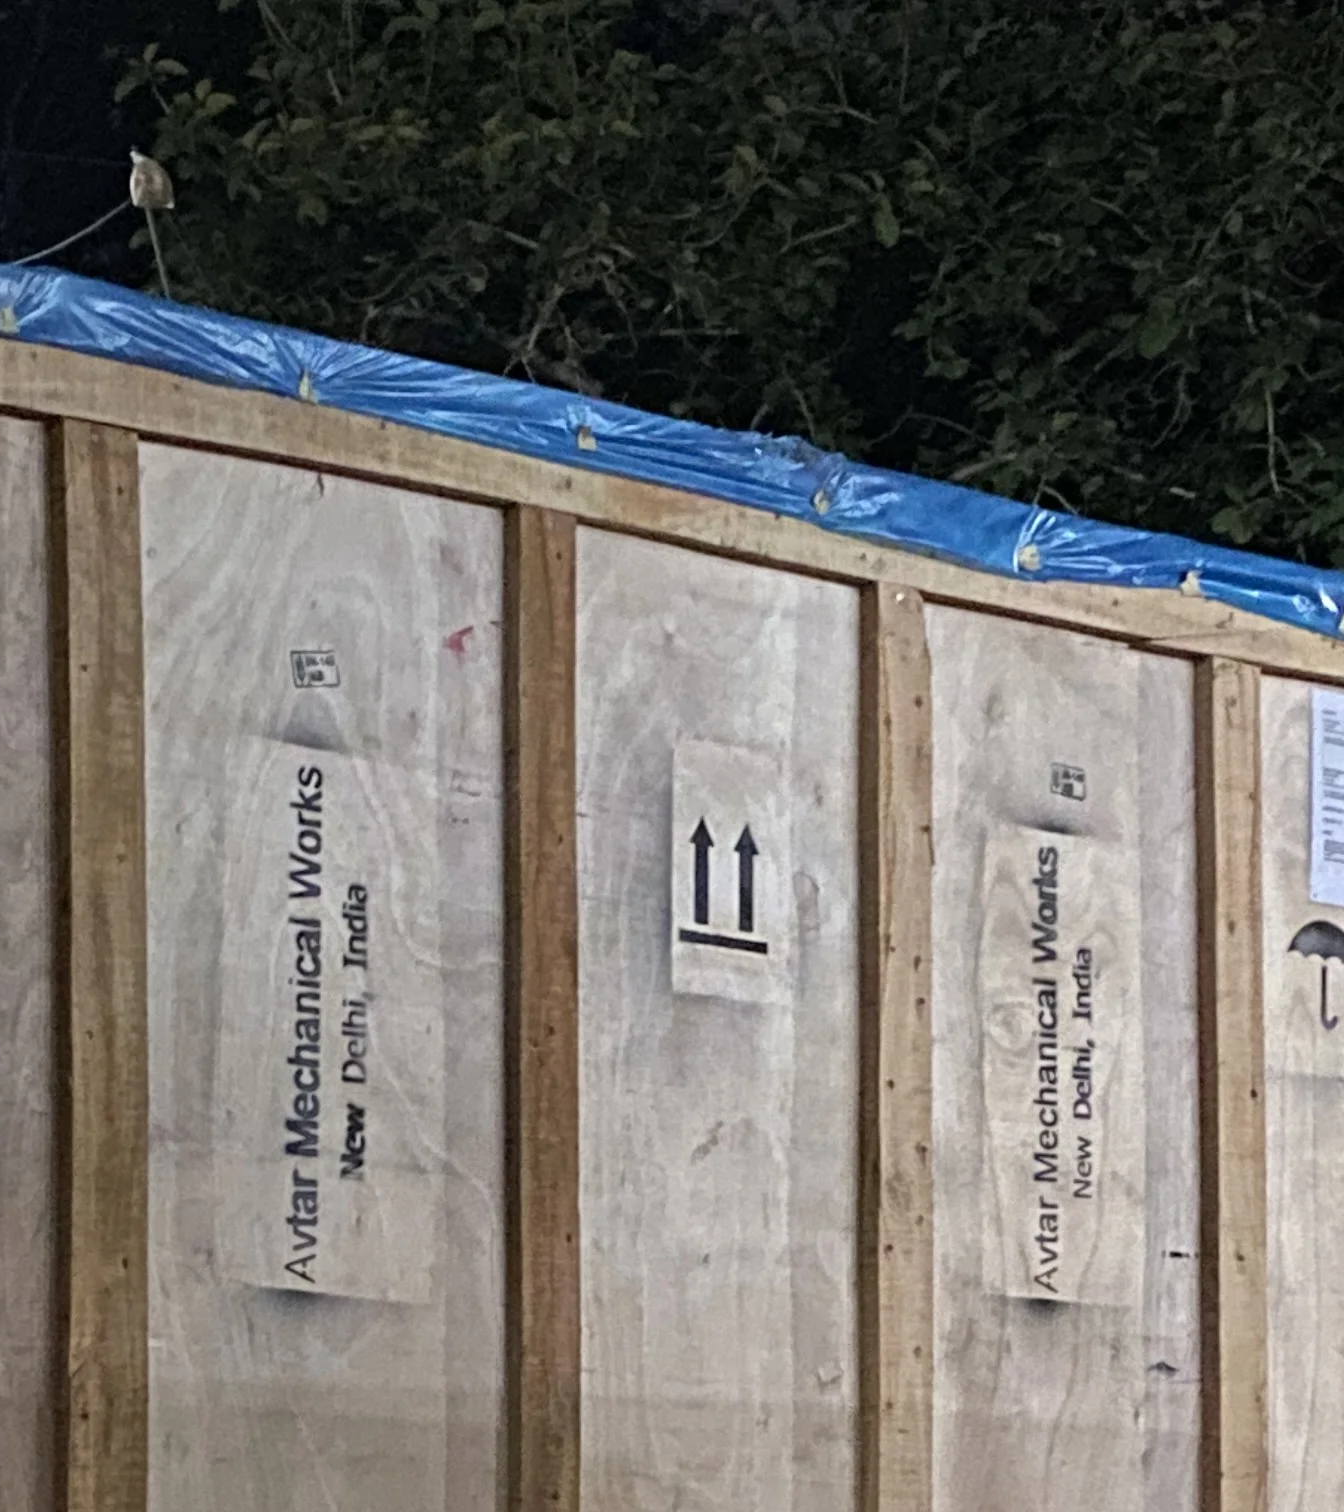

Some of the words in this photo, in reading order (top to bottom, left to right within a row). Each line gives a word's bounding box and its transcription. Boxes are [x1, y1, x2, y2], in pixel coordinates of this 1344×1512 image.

[288, 765, 324, 900] Works
[342, 882, 369, 972] India
[1031, 846, 1060, 965] Works
[1072, 947, 1093, 1023] India
[284, 915, 323, 1159] Mechanical
[340, 990, 376, 1085] Delhi,
[1031, 976, 1059, 1184] Mechanical
[1072, 1038, 1096, 1121] Delhi,
[339, 1102, 368, 1183] New
[1072, 1135, 1093, 1200] New
[284, 1167, 319, 1285] Avtar
[1033, 1195, 1060, 1294] Avtar
